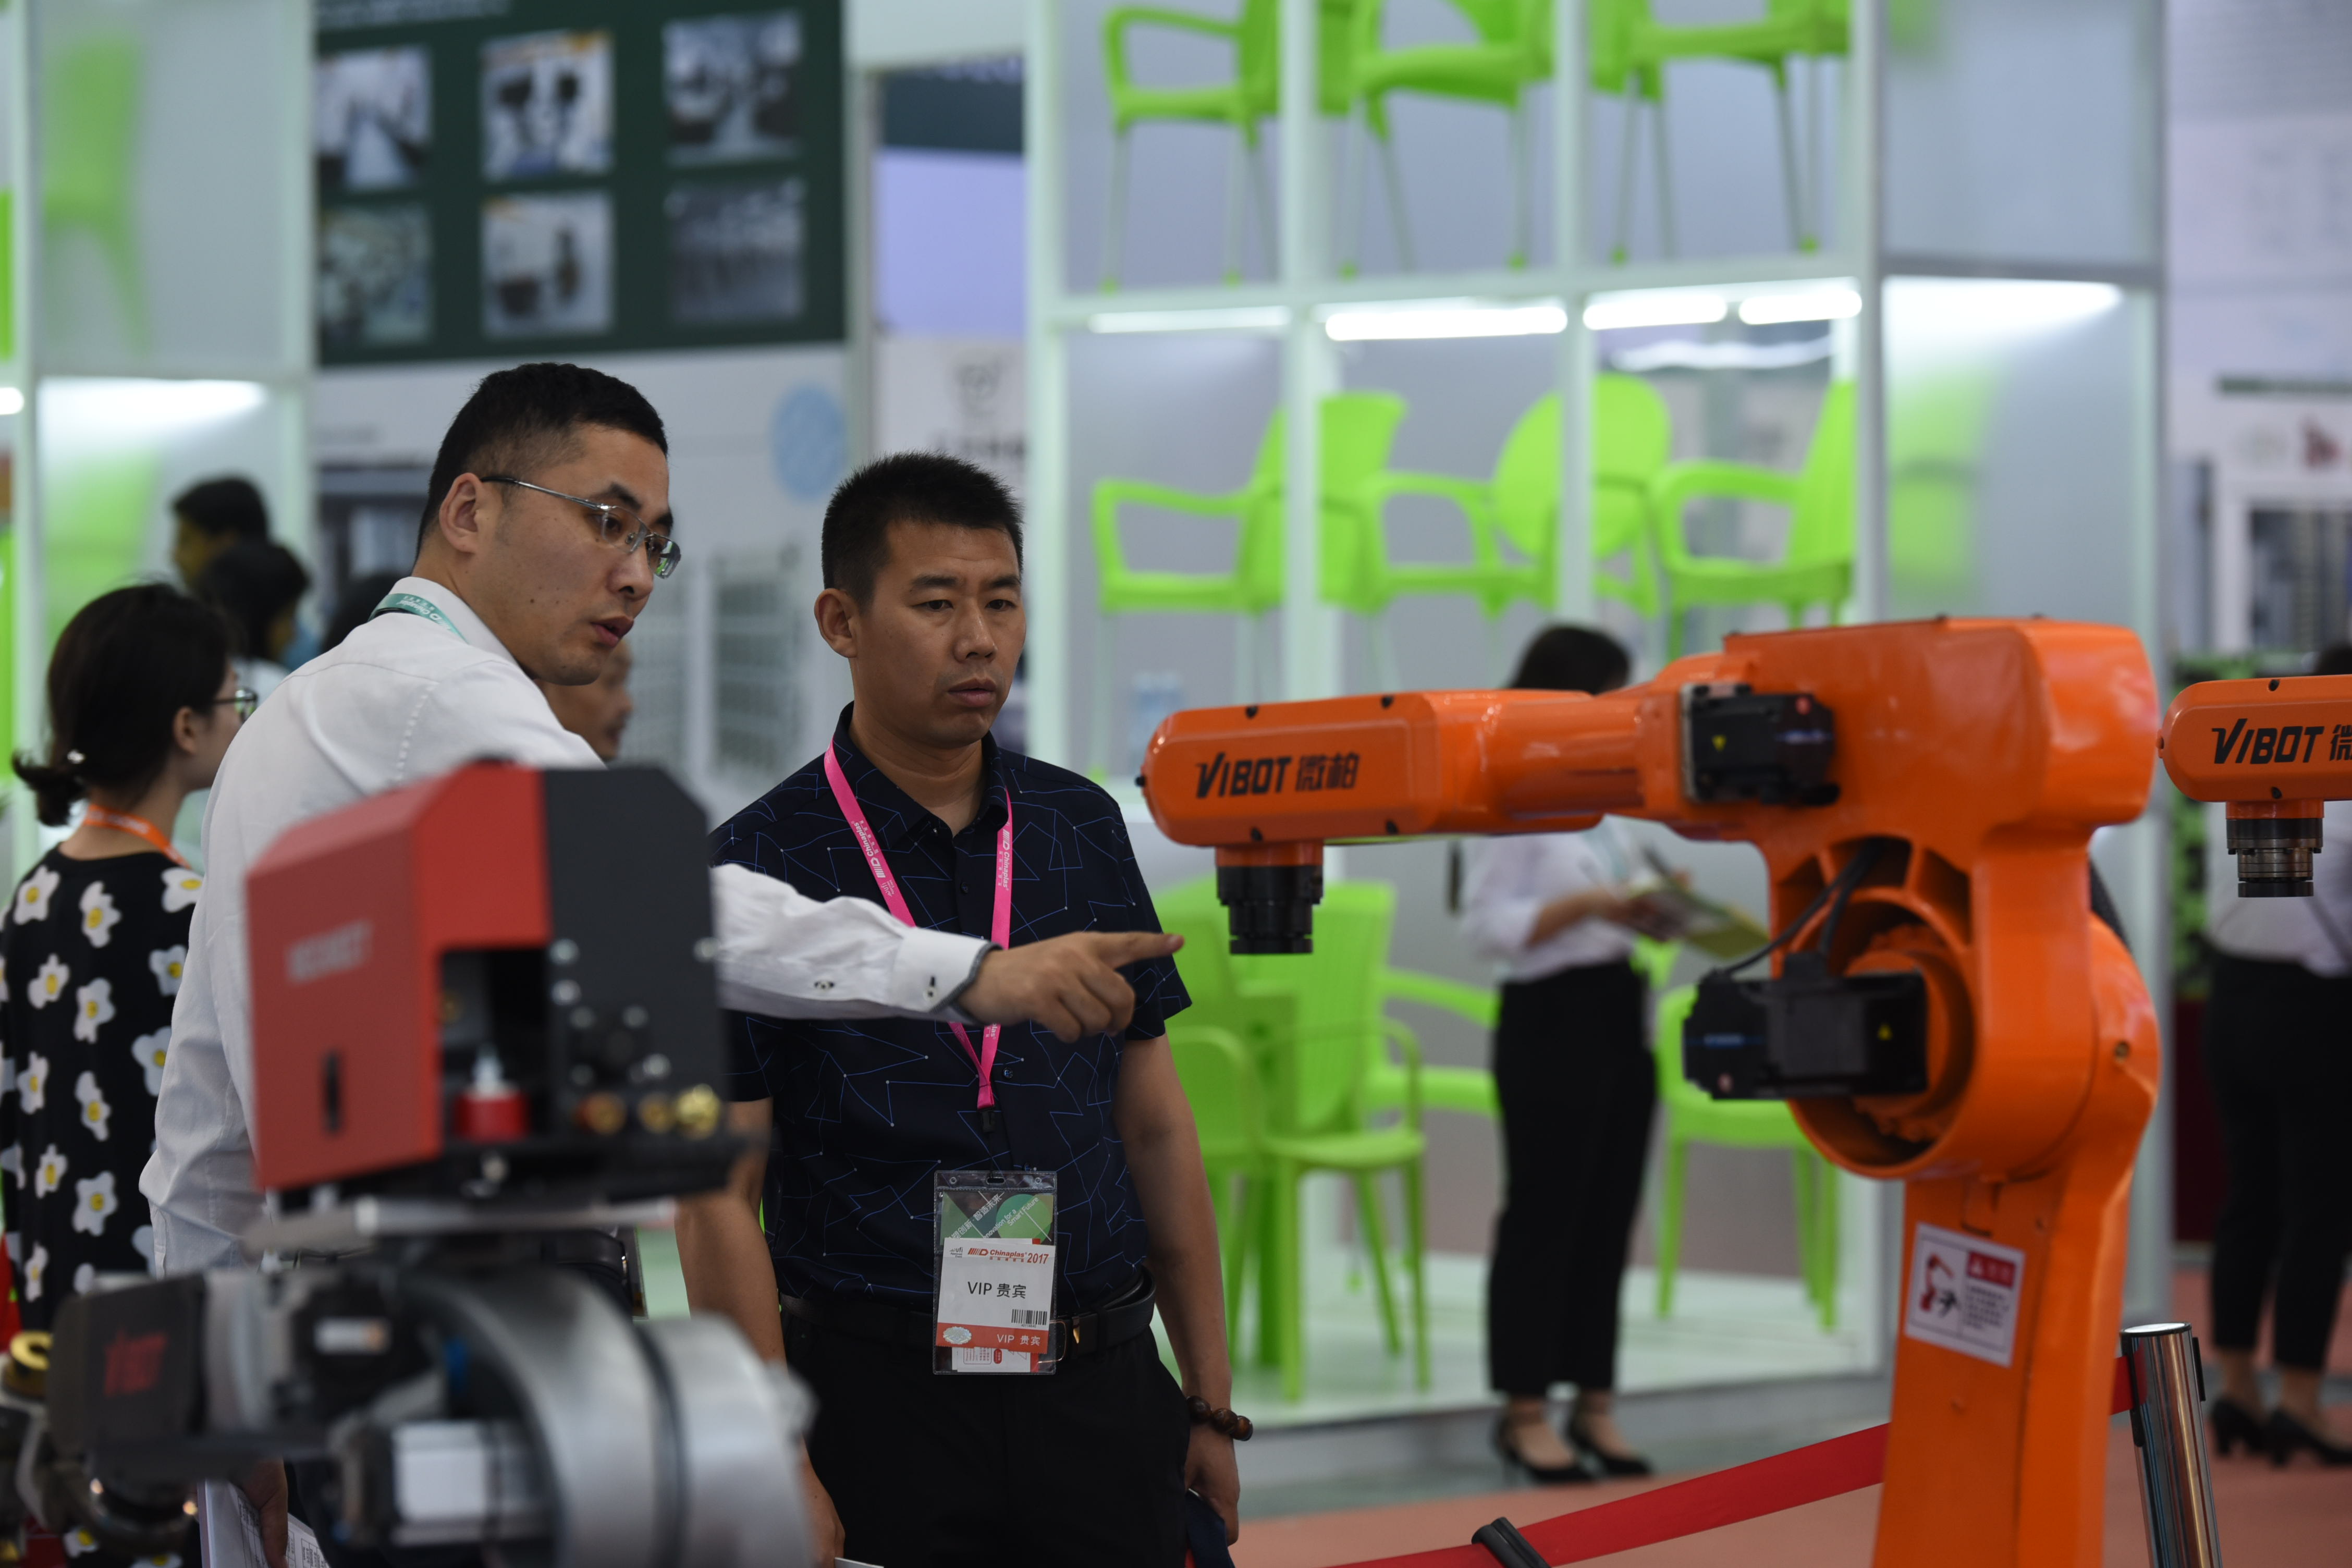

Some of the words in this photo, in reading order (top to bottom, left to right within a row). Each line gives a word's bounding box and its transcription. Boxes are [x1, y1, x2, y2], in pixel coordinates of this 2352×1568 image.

[2212, 718, 2324, 764] VIBOT
[1196, 752, 1292, 798] VIBOT
[1004, 1211, 1012, 1219] for
[1007, 1209, 1024, 1226] Smart
[1022, 1197, 1039, 1211] Future
[1027, 1253, 1049, 1264] 2017
[967, 1281, 992, 1295] VIP
[997, 1283, 1026, 1299] 贵宾
[997, 1334, 1014, 1343] VIP
[1020, 1335, 1041, 1346] 贵宾
